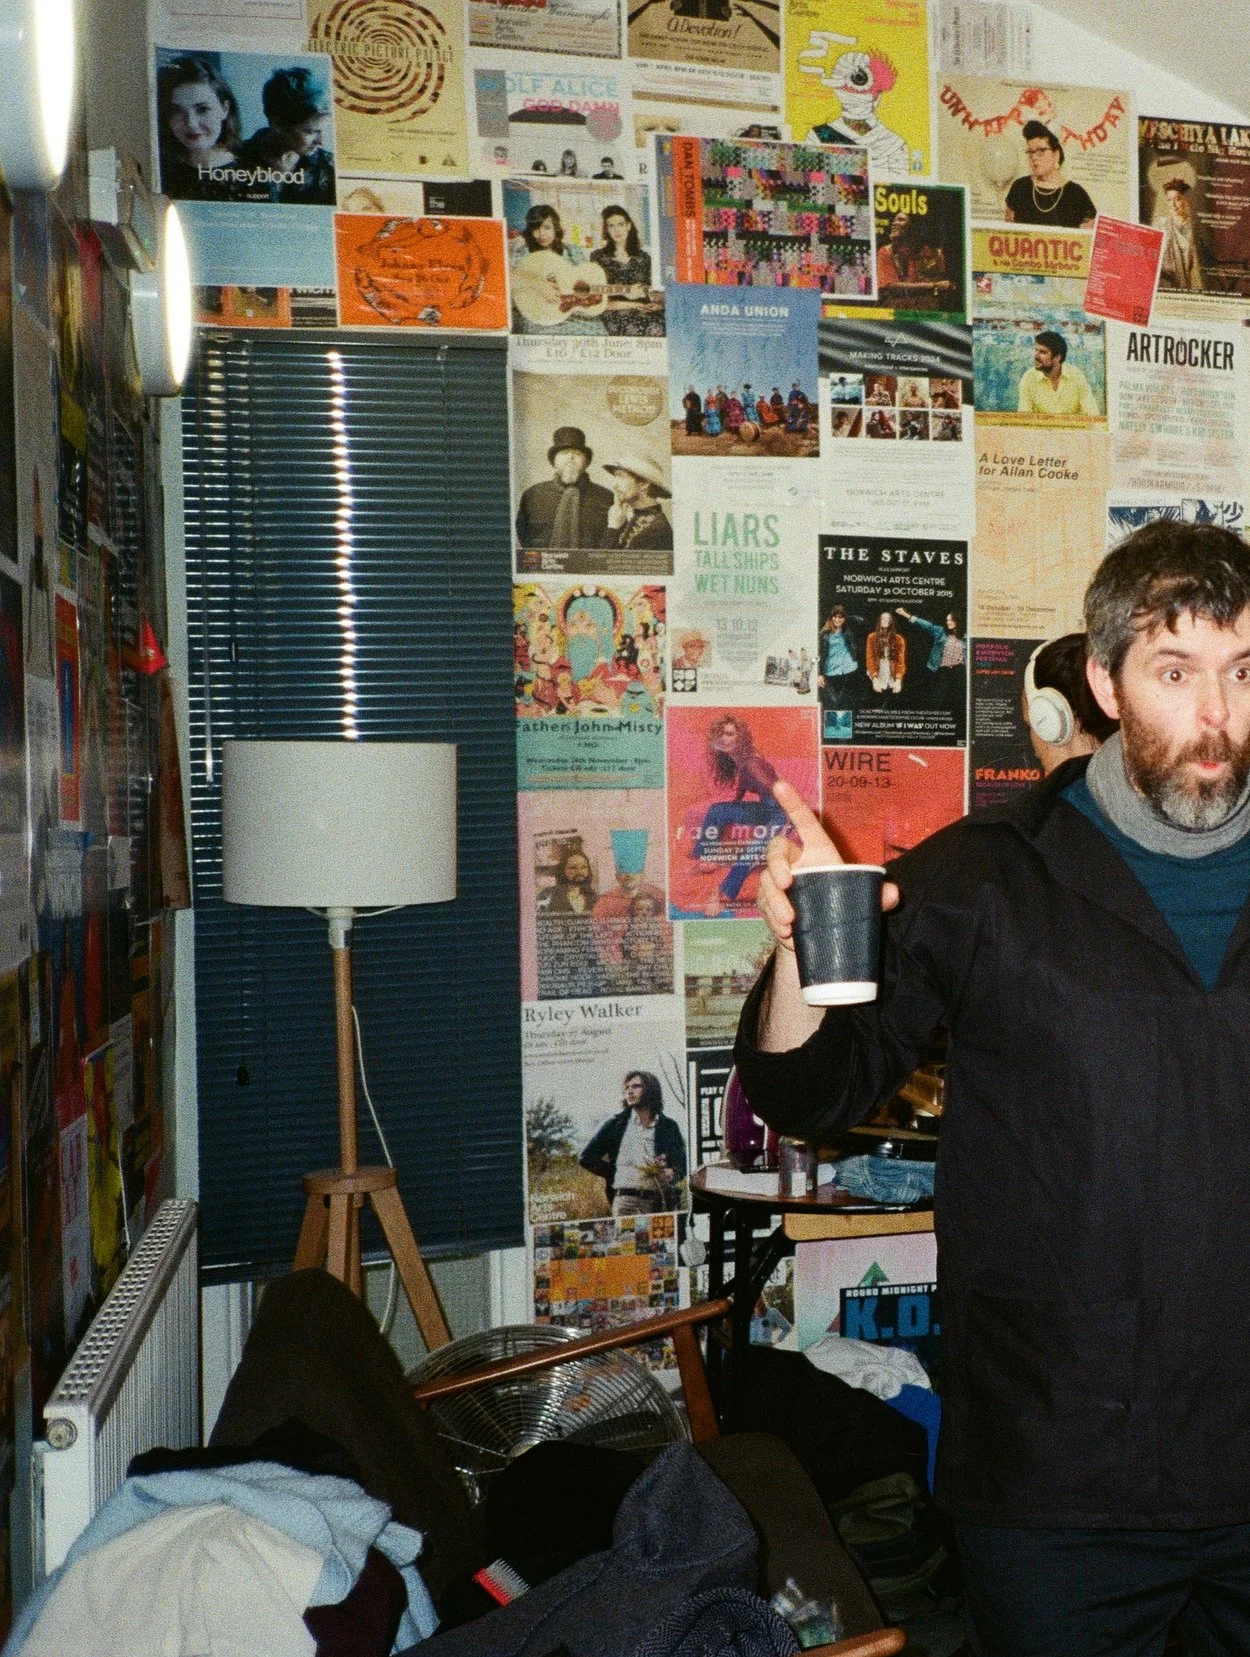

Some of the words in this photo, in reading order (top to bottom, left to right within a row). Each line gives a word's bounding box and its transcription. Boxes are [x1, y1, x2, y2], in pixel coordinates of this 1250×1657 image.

[364, 40, 411, 58] PICTURE
[552, 76, 620, 99] ALICE
[682, 142, 696, 170] DAN
[198, 164, 306, 186] Honeyblood
[875, 187, 928, 215] Souls
[988, 234, 1083, 262] QUANTIC
[700, 304, 742, 317] ANDA
[744, 305, 789, 319] UNION
[849, 350, 891, 363] MAKING
[1126, 332, 1235, 371] ARTROCKER
[979, 454, 989, 464] A
[992, 454, 1020, 466] Love
[1024, 456, 1068, 468] Letter
[979, 465, 996, 477] for
[999, 466, 1034, 479] Allan
[1038, 469, 1080, 481] Cooke
[693, 511, 781, 549] LIARS
[693, 551, 733, 570] TALL
[735, 552, 780, 571] SHIPS
[824, 546, 870, 562] THE
[881, 549, 965, 566] STAVES
[693, 573, 733, 594] WET
[734, 575, 780, 596] NUNS
[843, 574, 888, 584] NORWICH
[889, 576, 911, 585] ARTS
[912, 577, 946, 587] CENTRE
[835, 584, 882, 595] SATURDAY
[893, 588, 936, 597] OCTOBER
[573, 720, 611, 735] John
[618, 721, 663, 736] Misty
[824, 750, 892, 774] WIRE
[826, 775, 893, 789] 20-09-13
[974, 768, 1041, 783] FRANKO
[675, 822, 720, 840] rae
[524, 1006, 576, 1026] Ryley
[580, 1003, 643, 1018] Walker
[880, 1286, 926, 1296] MIDNIGHT
